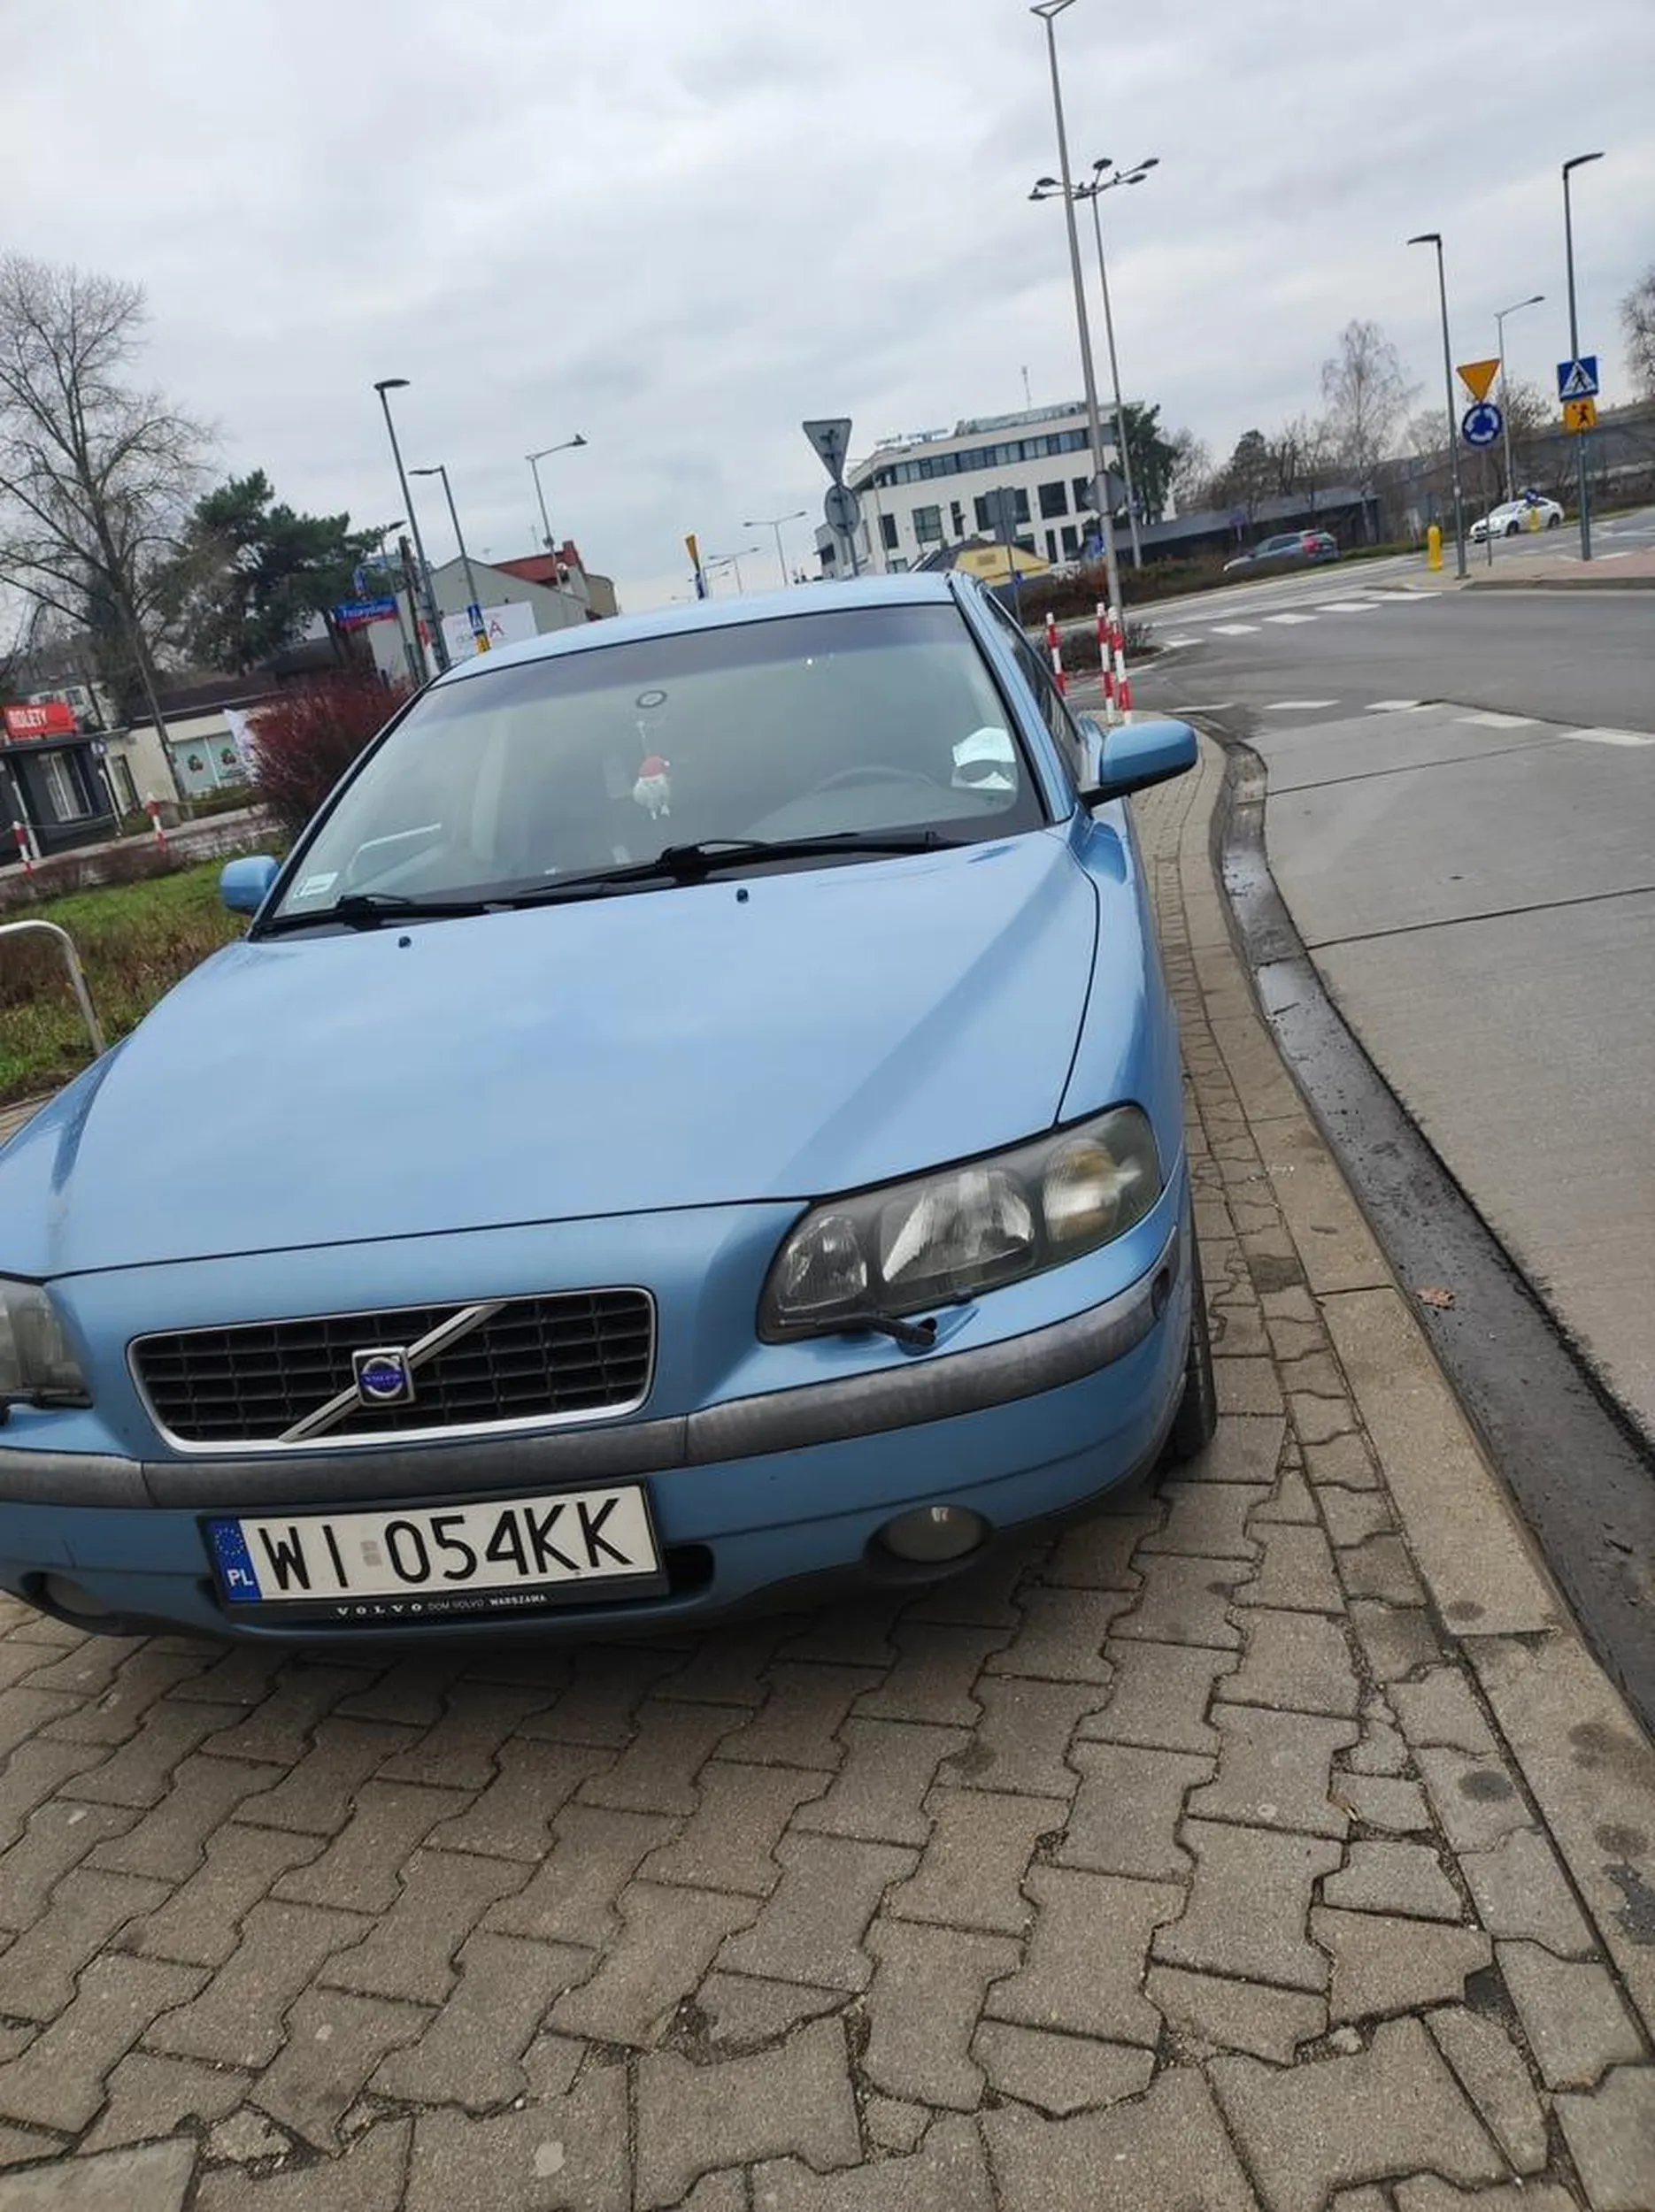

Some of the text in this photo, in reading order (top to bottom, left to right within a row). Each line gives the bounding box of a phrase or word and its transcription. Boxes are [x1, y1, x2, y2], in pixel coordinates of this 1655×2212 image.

[258, 1498, 635, 1590] WI 054KK
[228, 1569, 254, 1586] PL
[337, 1603, 422, 1616] VOLVO
